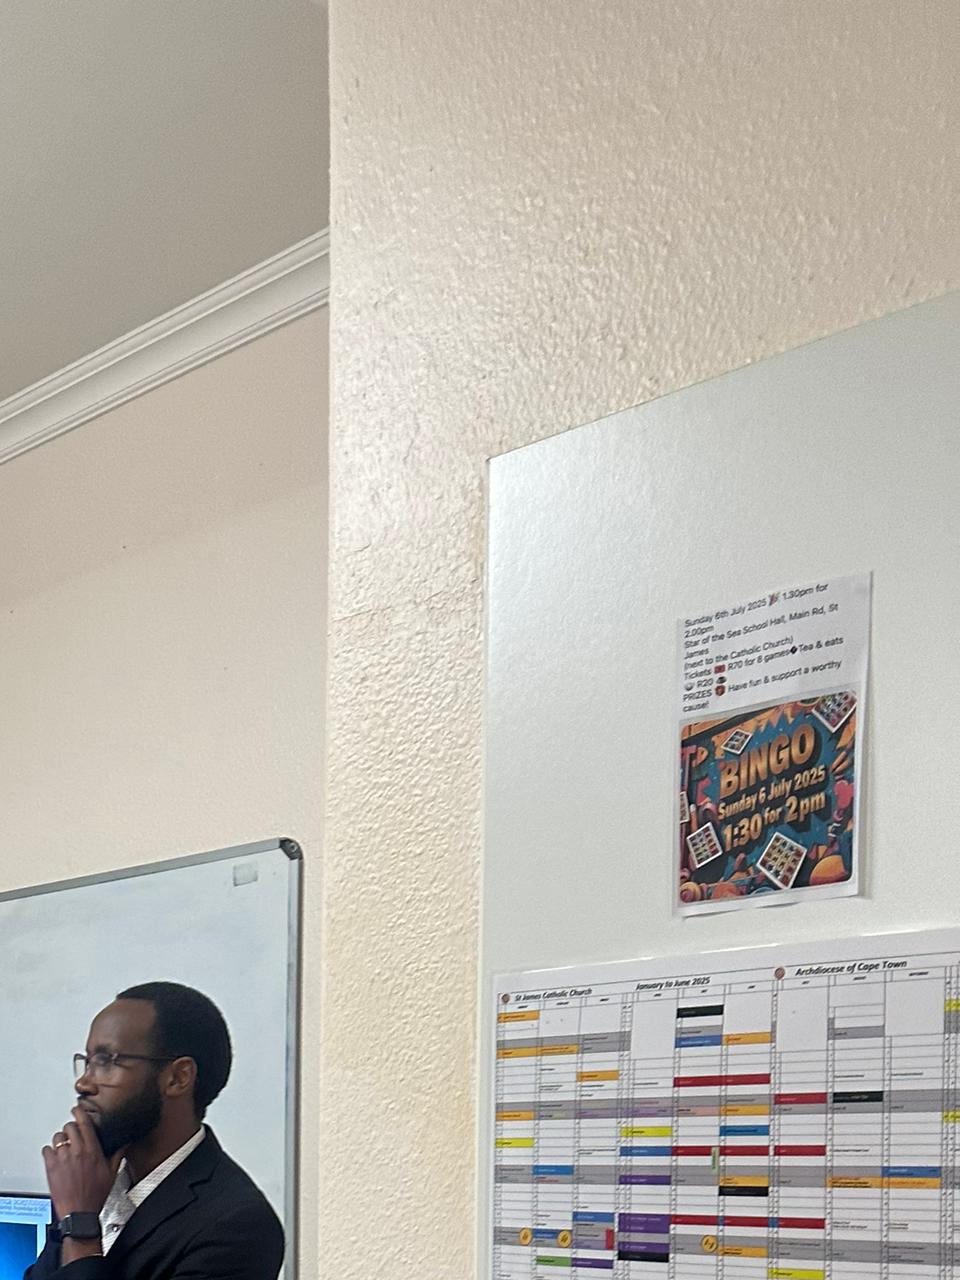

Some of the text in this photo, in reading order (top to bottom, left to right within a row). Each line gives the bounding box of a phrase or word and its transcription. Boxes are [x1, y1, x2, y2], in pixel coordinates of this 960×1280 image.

[685, 583, 829, 627] Sunday 6th July 2025 1.30pm for
[684, 640, 700, 649] Star
[701, 635, 710, 645] of
[711, 633, 725, 642] the
[726, 629, 742, 639] Sea
[742, 620, 768, 635] School
[789, 610, 810, 621] Main
[812, 605, 826, 615] Rd,
[828, 603, 839, 612] St
[684, 625, 714, 639] 2.00pm
[684, 648, 709, 659] James
[684, 669, 712, 680] Tickets
[727, 661, 743, 671] R70
[744, 658, 756, 667] for
[764, 649, 791, 663] games
[798, 643, 814, 652] Tea
[815, 640, 823, 649] &
[824, 637, 844, 647] eats
[705, 657, 714, 665] to
[715, 654, 729, 663] the
[730, 645, 761, 659] Catholic
[762, 635, 794, 651] Church)
[683, 689, 712, 702] PRIZES
[728, 682, 748, 692] Have
[749, 679, 762, 687] fun
[763, 675, 770, 683] &
[771, 667, 802, 681] support
[811, 660, 842, 672] worthy
[696, 678, 714, 688] R20
[719, 723, 815, 799] BINGO
[718, 764, 826, 820] Sunday 6 July 2025
[723, 813, 763, 852] 1:30
[764, 806, 782, 825] for
[636, 983, 664, 991] January
[665, 980, 673, 988] to
[691, 976, 711, 986] 2025
[795, 960, 908, 976] Archdiocese of Cape Town
[515, 988, 593, 1002] St James Catholic Church
